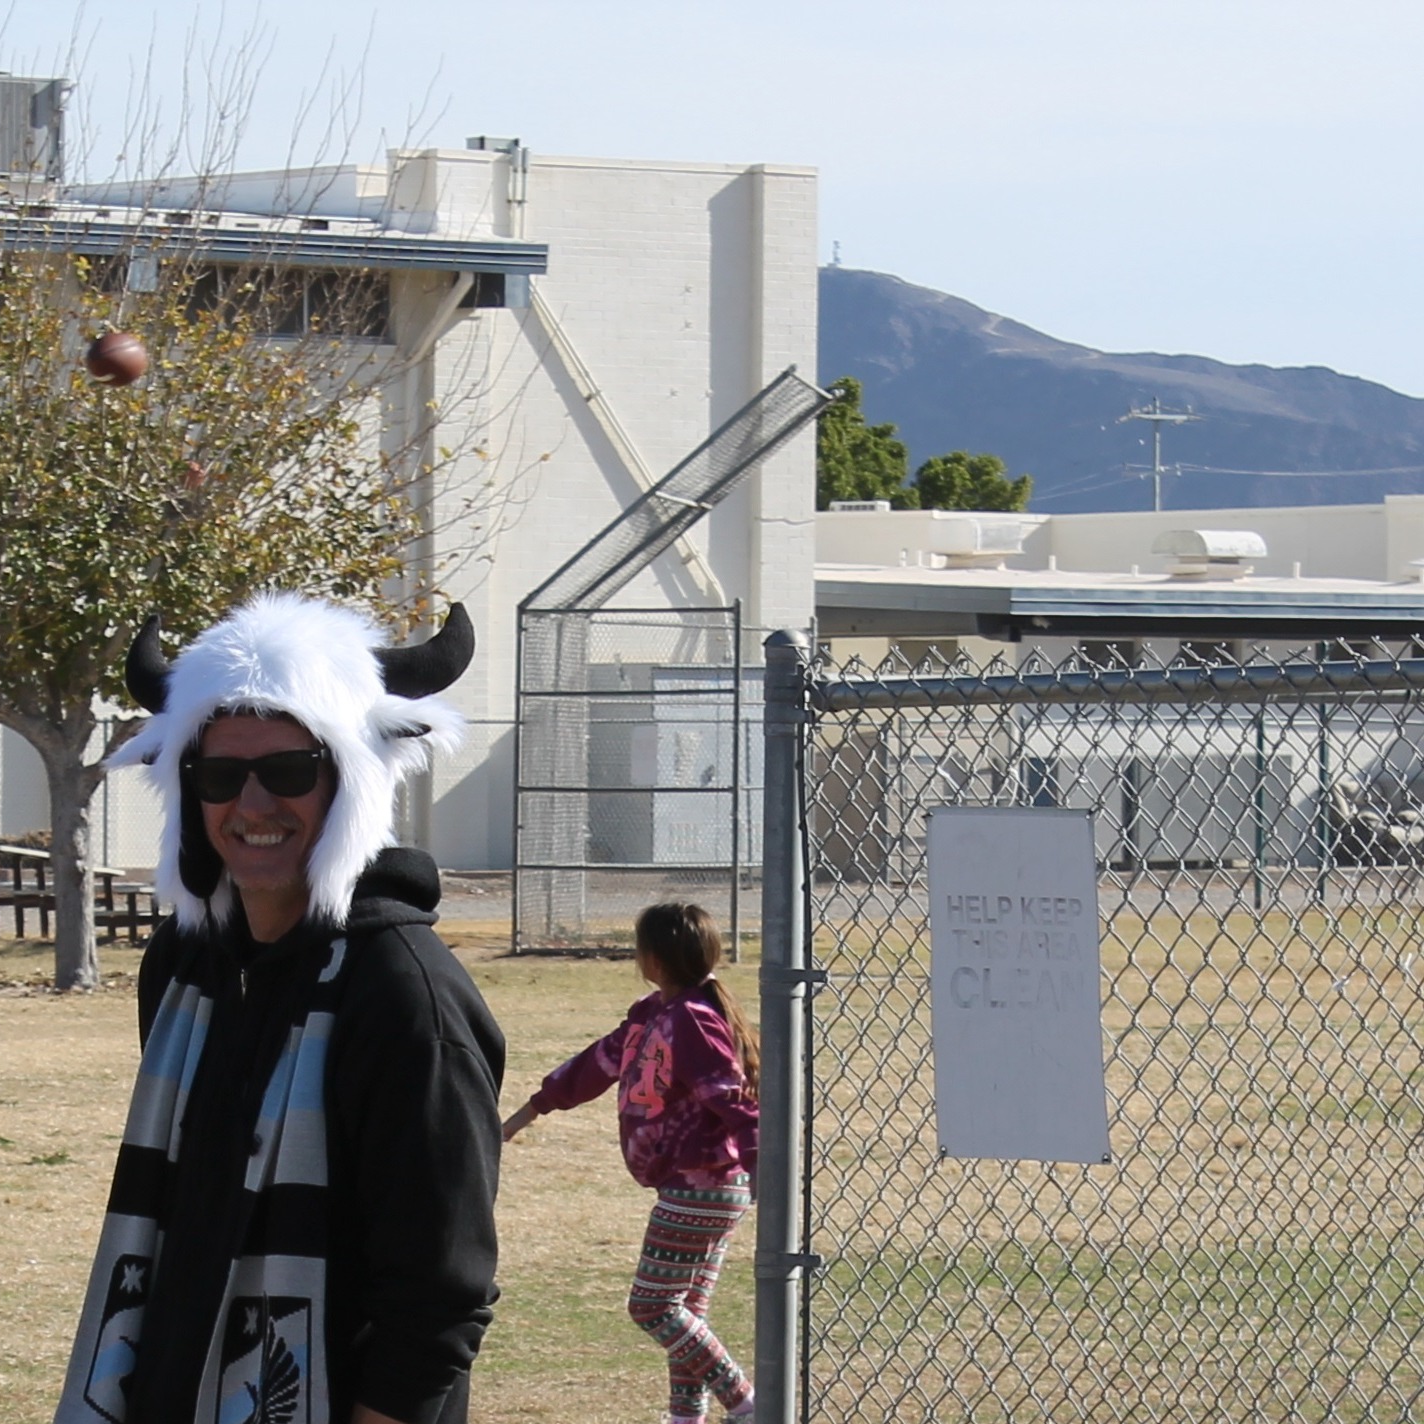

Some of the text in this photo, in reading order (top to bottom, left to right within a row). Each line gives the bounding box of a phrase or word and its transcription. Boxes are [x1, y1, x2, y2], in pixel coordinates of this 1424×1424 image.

[947, 895, 1083, 926] HELP KEEP
[951, 929, 1082, 961] THIS AREA
[950, 966, 1085, 1012] CLEAN
